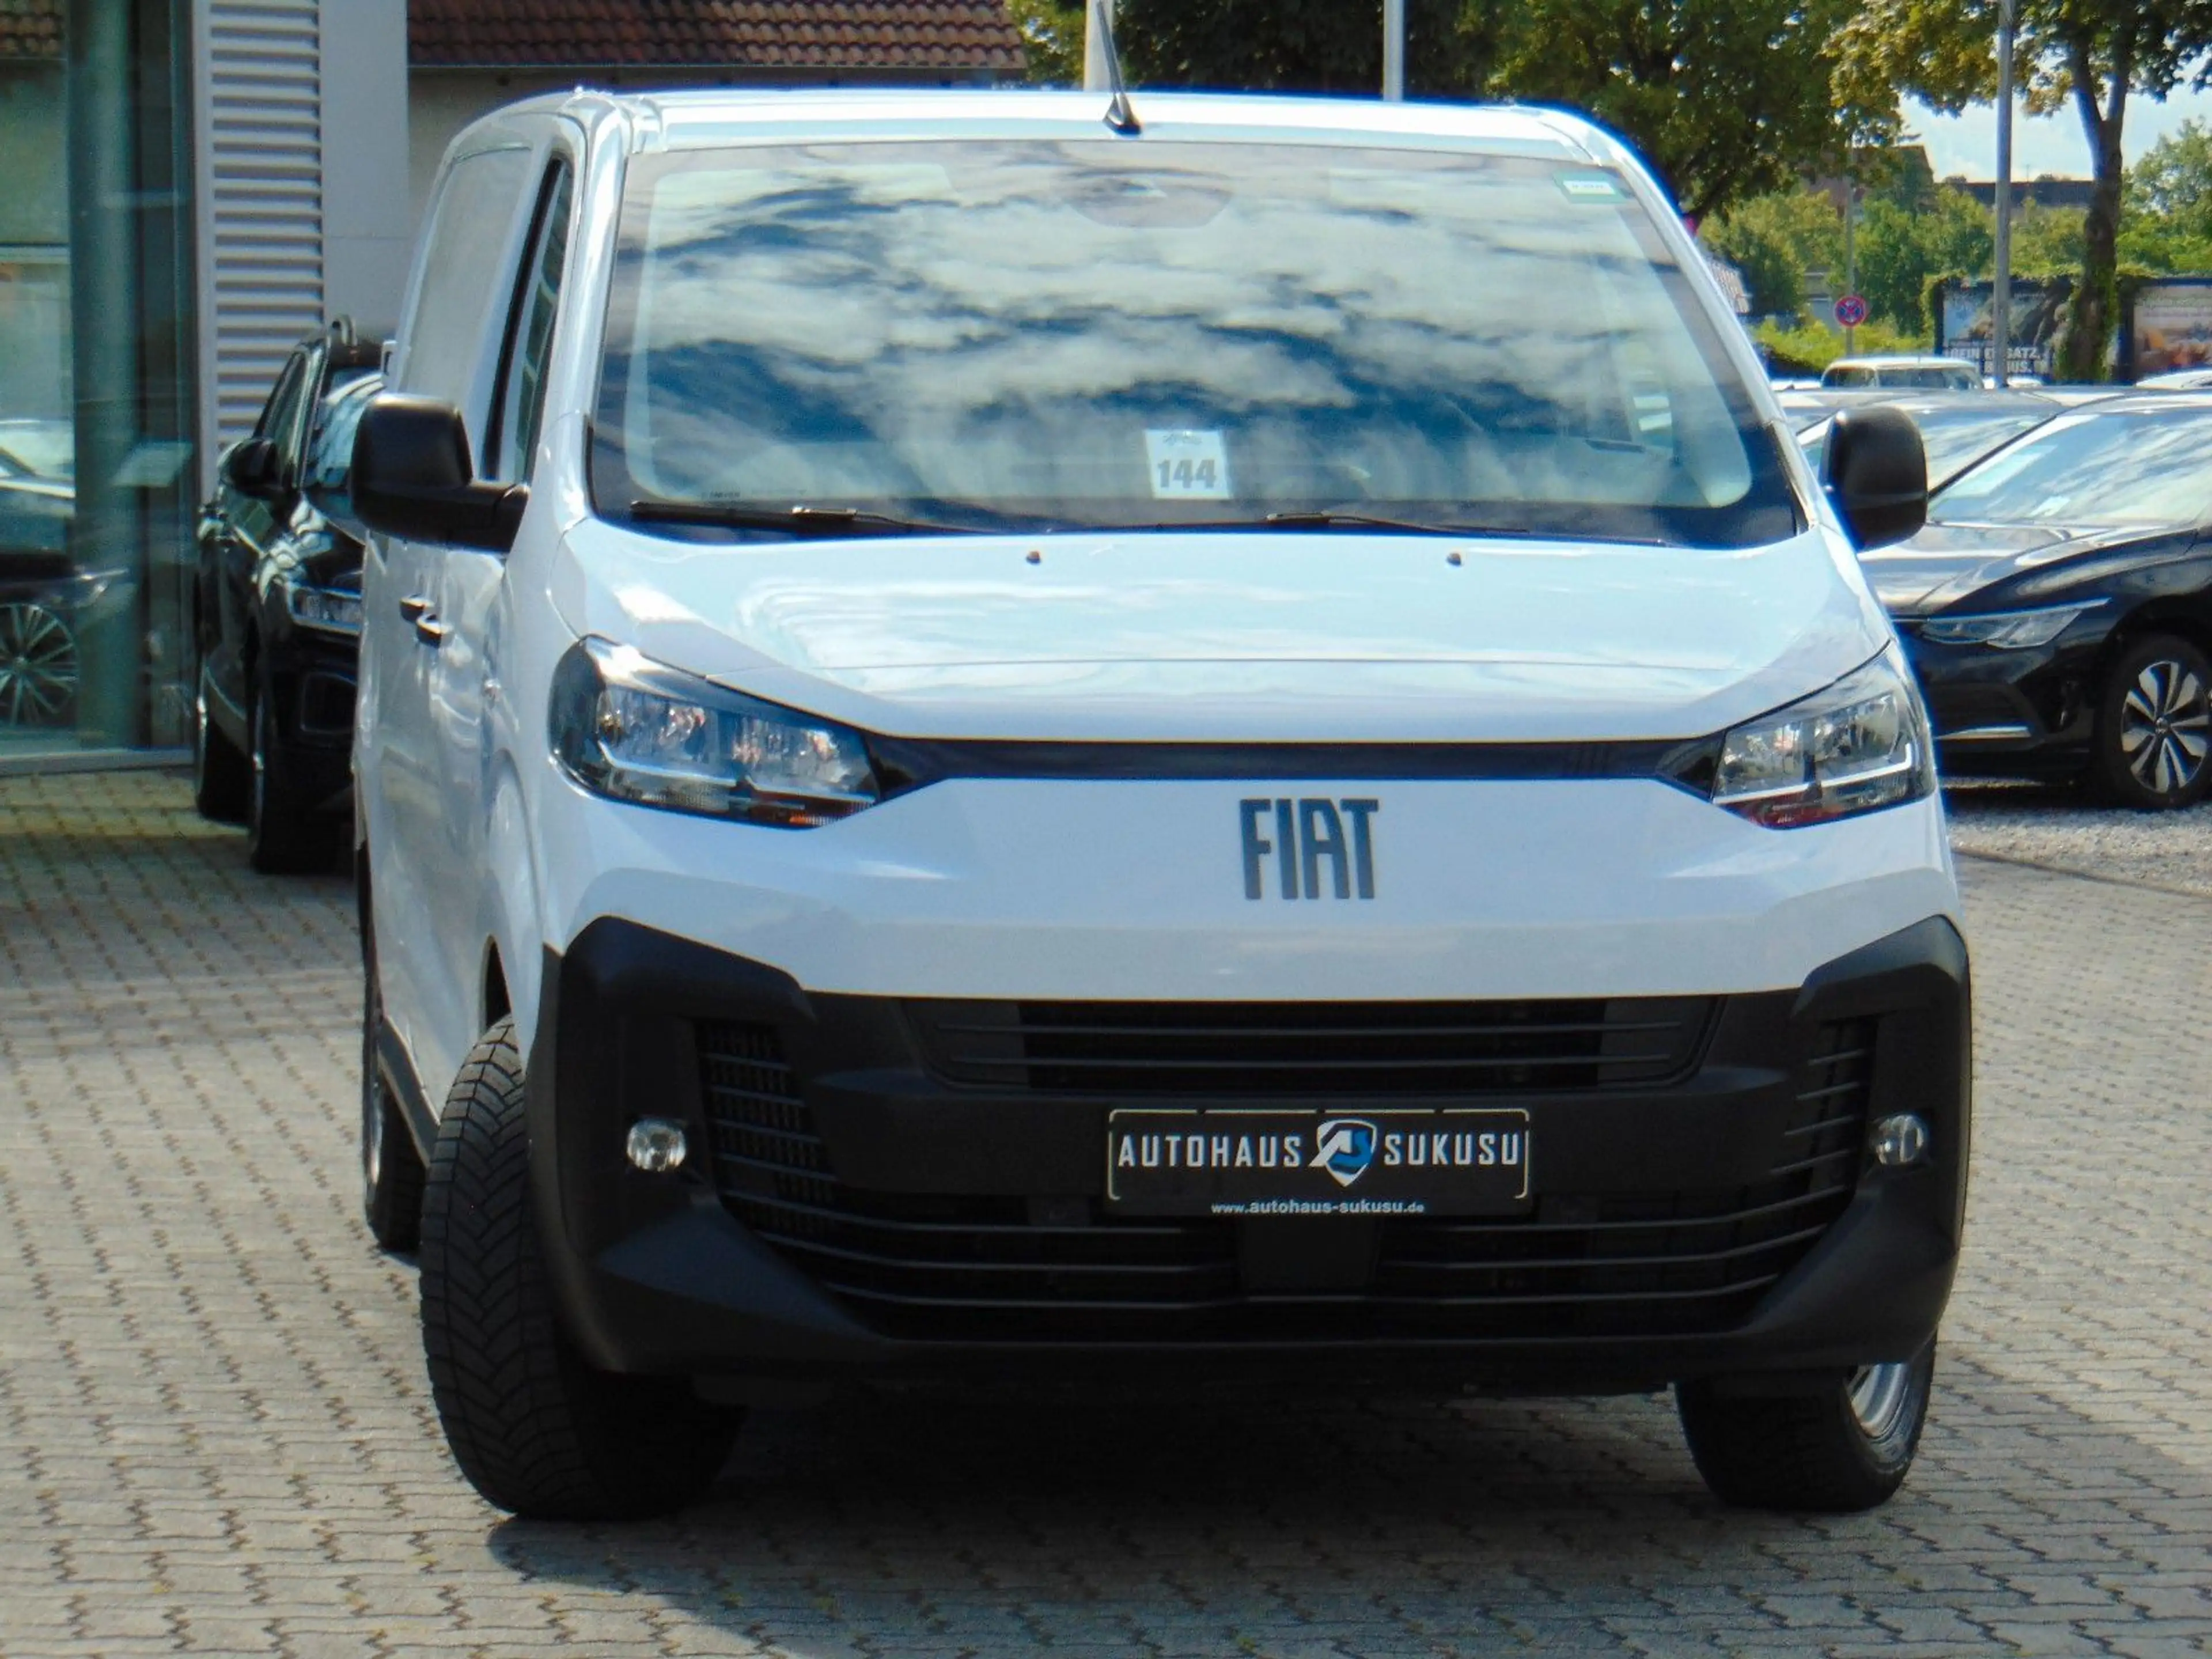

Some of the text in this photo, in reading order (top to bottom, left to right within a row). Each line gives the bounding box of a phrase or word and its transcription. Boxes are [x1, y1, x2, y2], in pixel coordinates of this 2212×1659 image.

[1158, 459, 1217, 488] 144
[1240, 798, 1379, 900] FIAT
[1118, 1135, 1301, 1167] AUTOHAUS
[1384, 1134, 1518, 1165] SUKUSU
[1211, 1199, 1425, 1214] www.autohaus-sukusu.de
